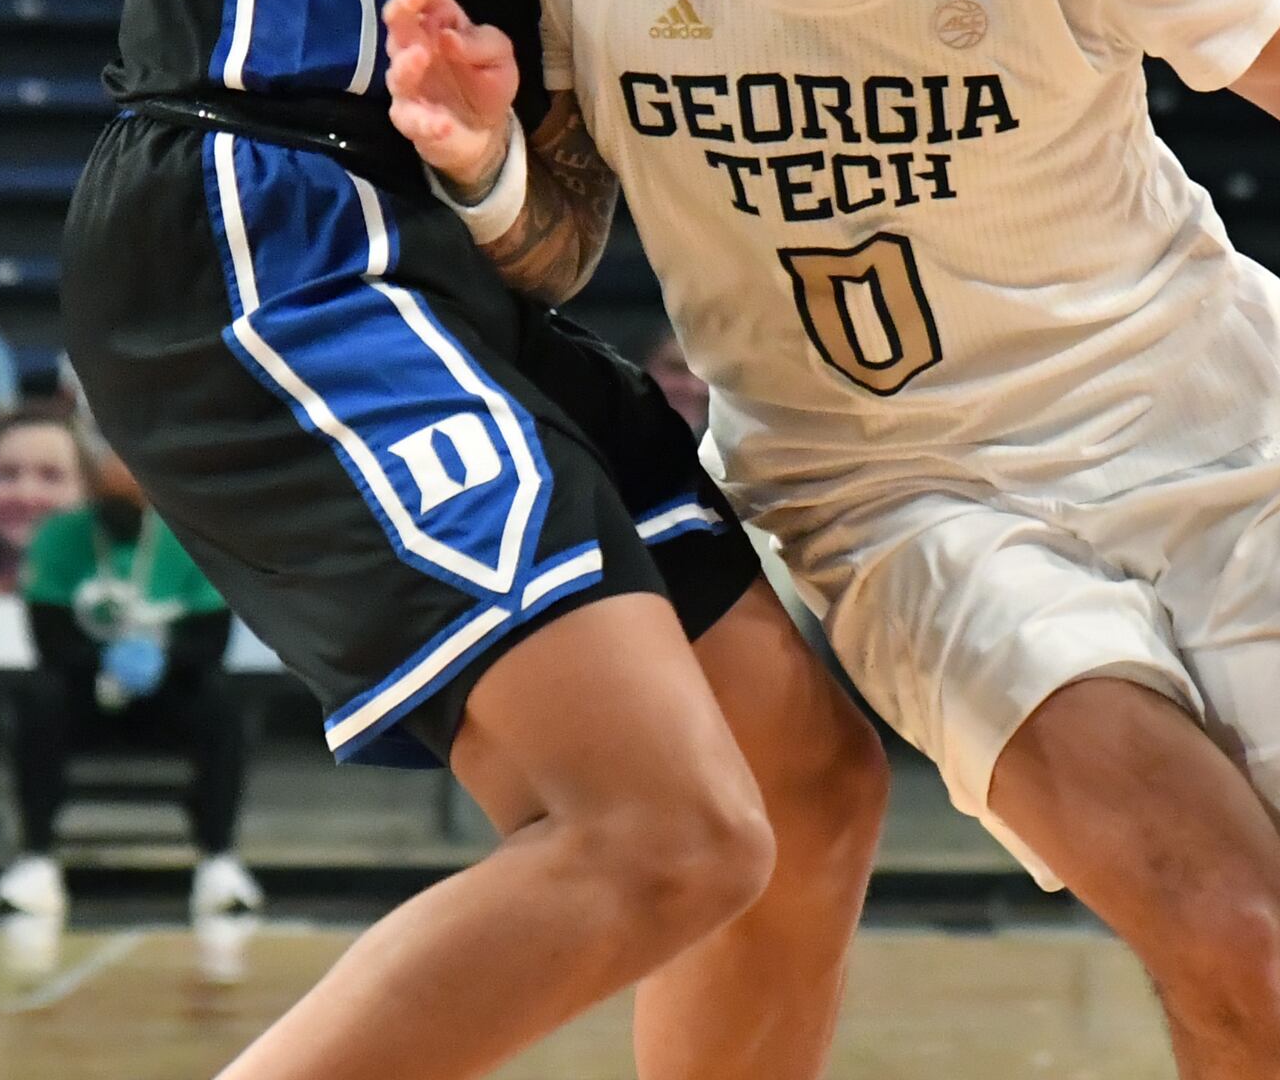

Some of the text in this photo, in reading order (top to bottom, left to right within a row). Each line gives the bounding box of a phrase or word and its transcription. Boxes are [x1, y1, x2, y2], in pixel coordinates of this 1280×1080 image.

[648, 24, 713, 39] adidas
[620, 71, 1020, 144] GEORGIA
[704, 151, 957, 222] TECH
[776, 231, 943, 397] 0
[387, 411, 502, 516] D
